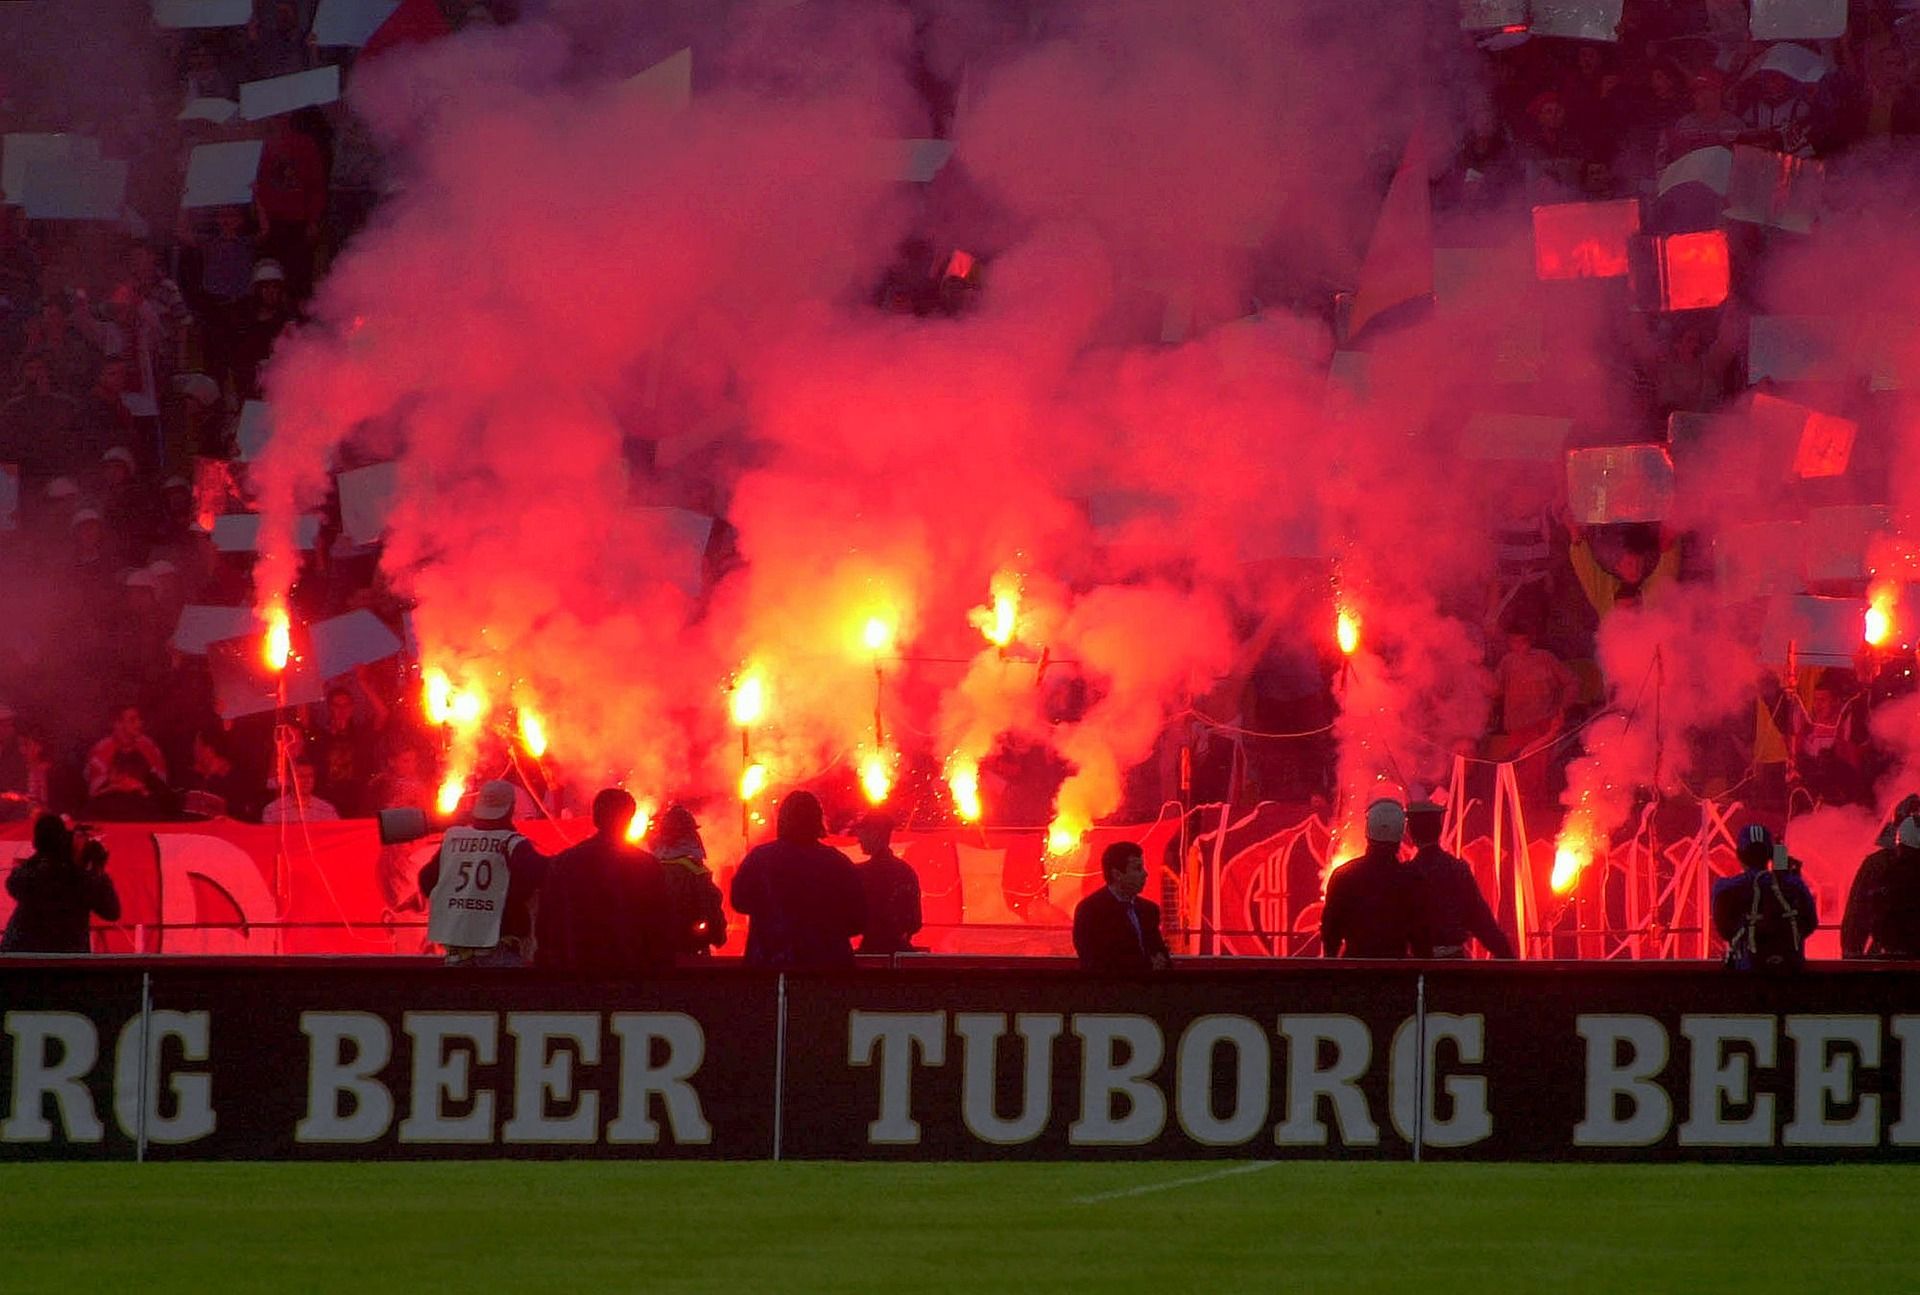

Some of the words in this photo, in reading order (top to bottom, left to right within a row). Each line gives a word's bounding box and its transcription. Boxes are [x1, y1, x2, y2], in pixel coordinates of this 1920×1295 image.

[455, 860, 492, 892] 50
[448, 898, 494, 911] PRESS
[294, 1011, 712, 1144] BEER
[848, 1010, 1493, 1146] TUBORG
